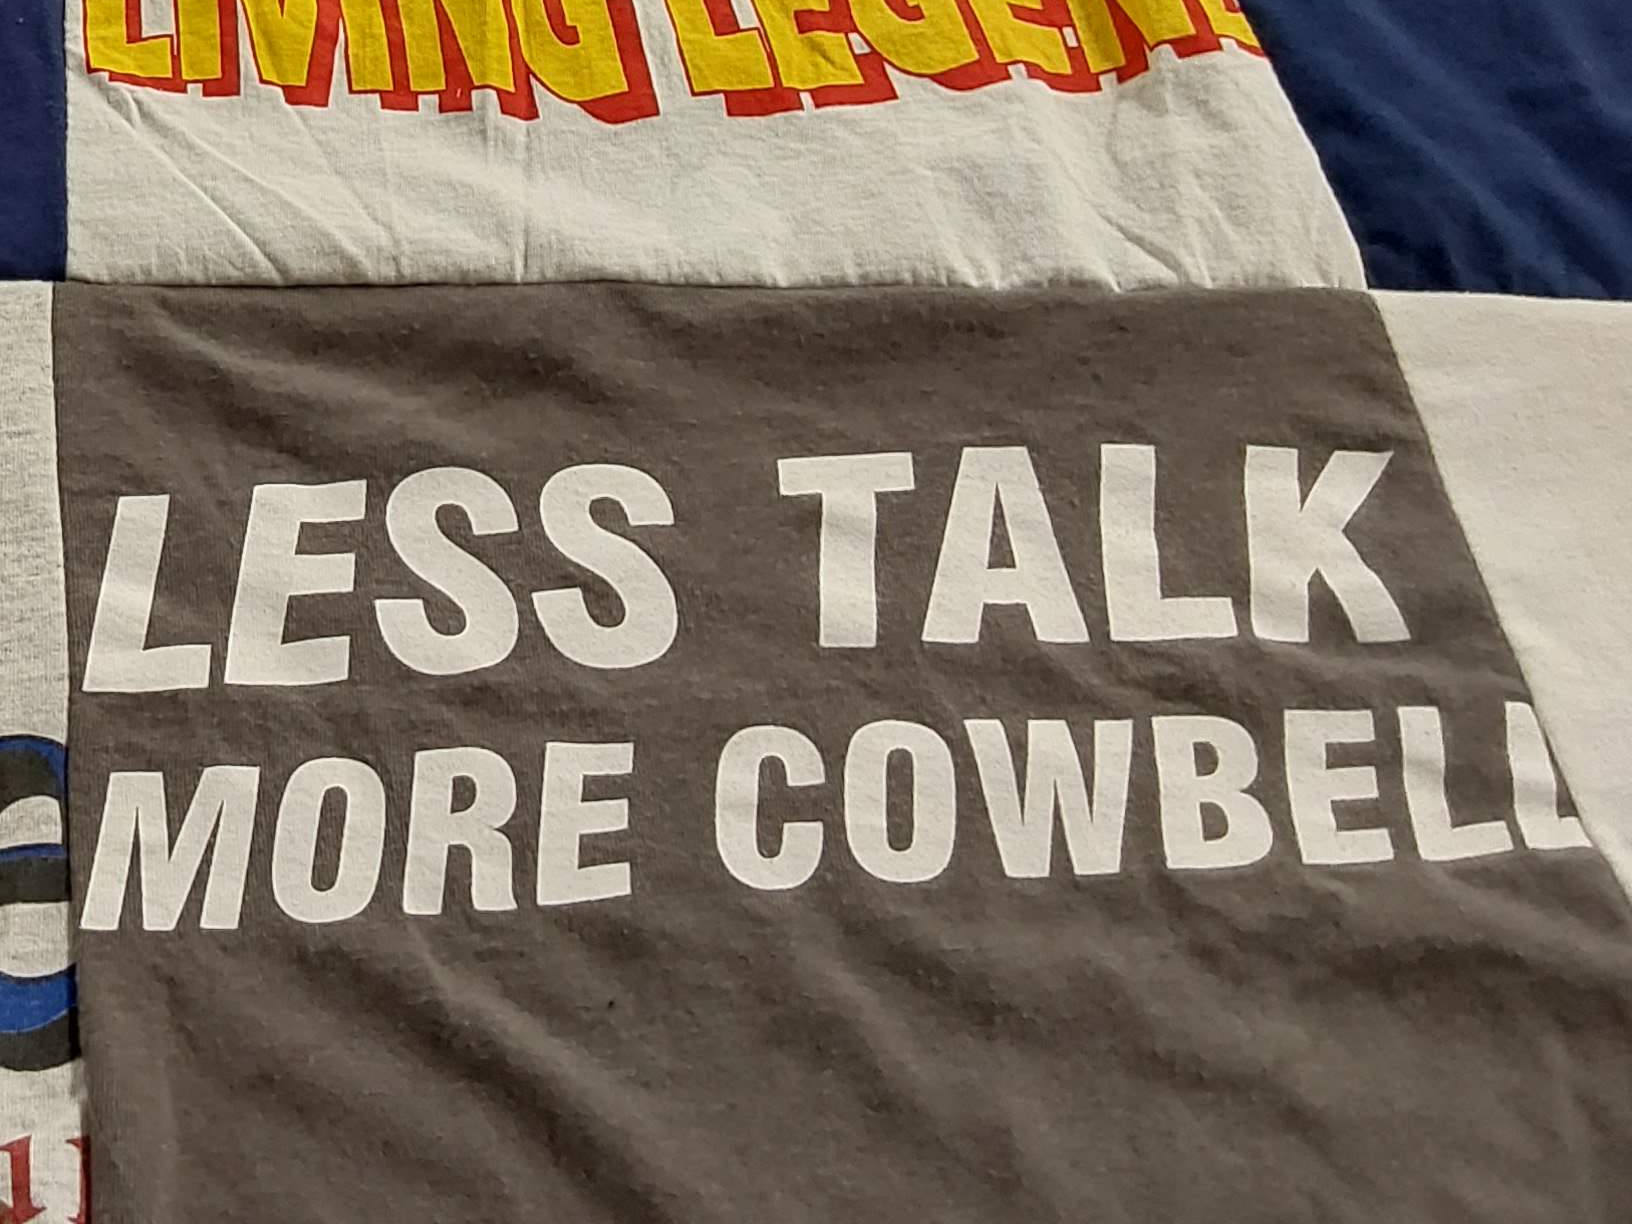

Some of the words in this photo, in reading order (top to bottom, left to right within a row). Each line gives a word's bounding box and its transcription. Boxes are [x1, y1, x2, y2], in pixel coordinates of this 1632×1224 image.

[81, 465, 679, 693] LESS
[776, 443, 1411, 649] TALK
[79, 741, 635, 932] MORE
[714, 700, 1594, 892] COWBELL
